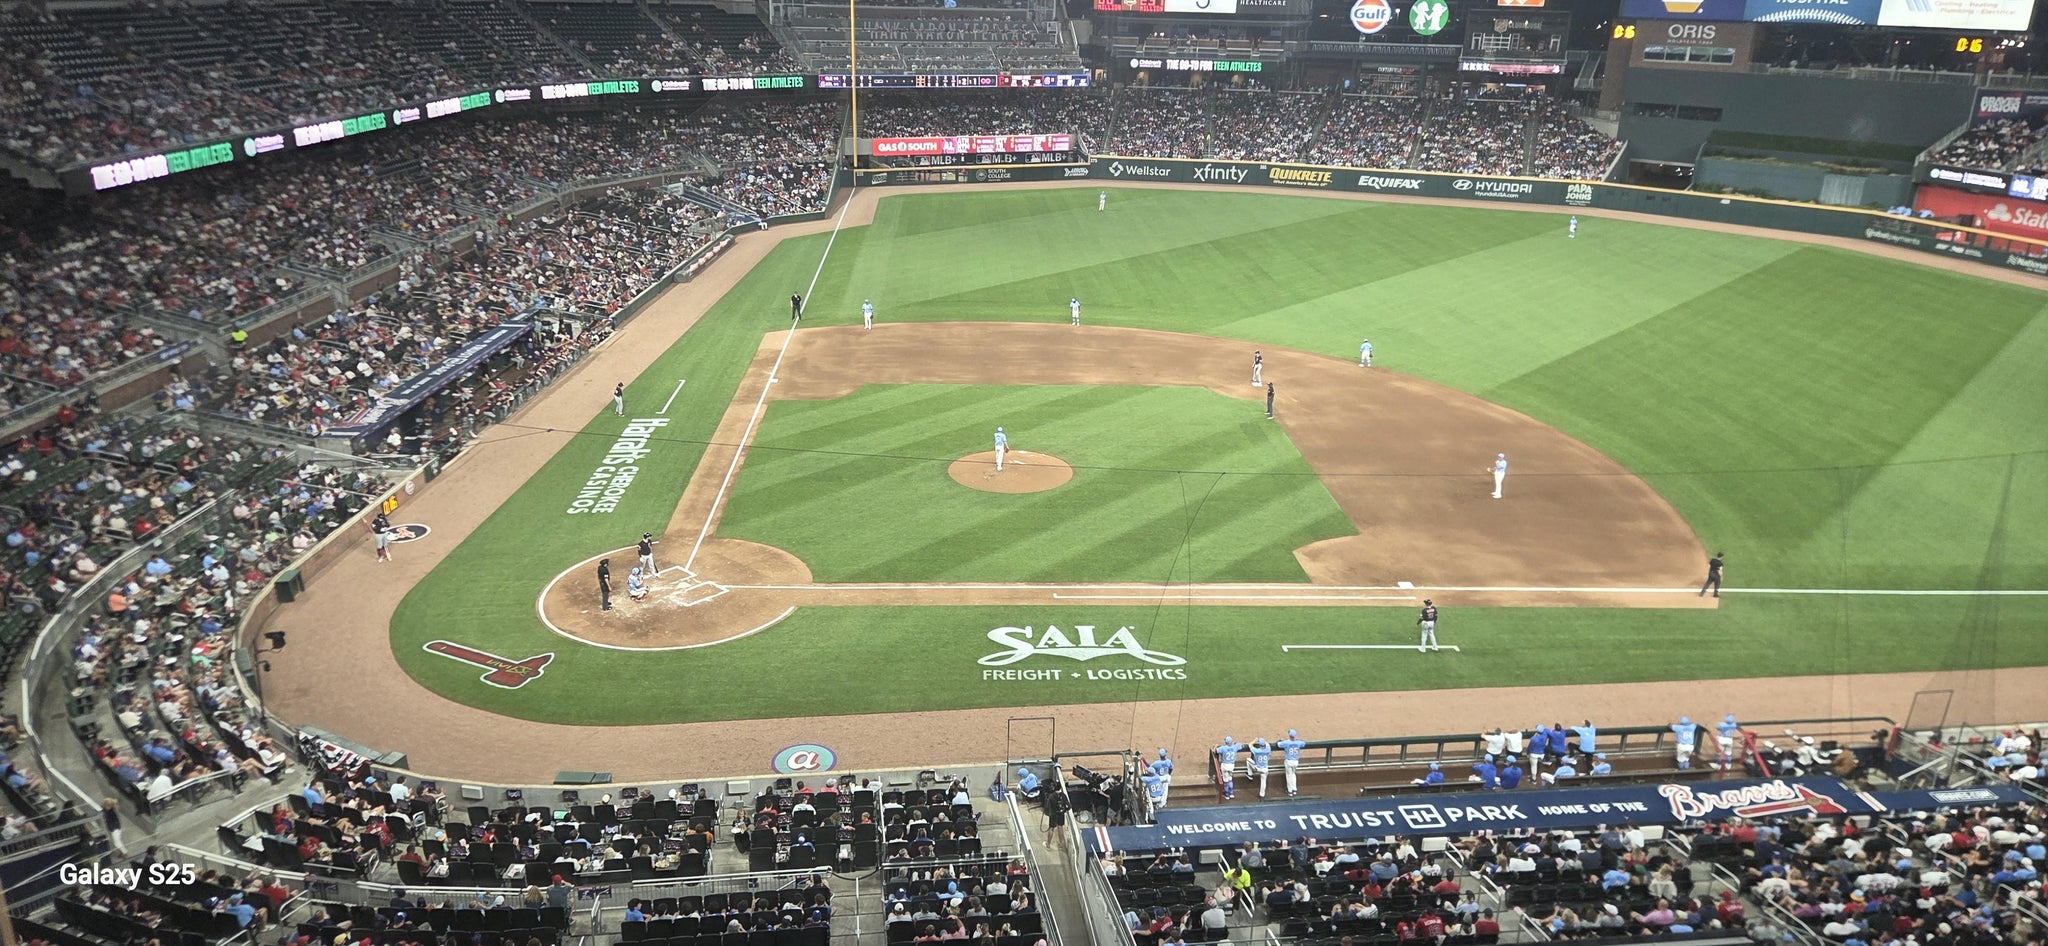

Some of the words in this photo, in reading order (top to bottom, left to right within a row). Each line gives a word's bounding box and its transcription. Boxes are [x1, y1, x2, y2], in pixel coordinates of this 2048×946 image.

[1354, 9, 1387, 20] Gulf
[1668, 24, 1716, 39] ORIS
[1214, 61, 1229, 71] TEEN
[1230, 61, 1261, 72] ATHLETES
[588, 82, 603, 95] TEEN
[603, 81, 639, 94] ATHLETES
[754, 78, 770, 88] TEEN
[772, 77, 803, 88] ATHLETES
[1980, 102, 2020, 113] VISION
[878, 143, 897, 152] GAS
[907, 142, 937, 151] SOUTH
[931, 156, 957, 165] MLB+
[1042, 153, 1066, 162] MLB+
[1126, 164, 1171, 177] Wellstar
[1193, 163, 1249, 183] xfinity
[1269, 167, 1332, 182] QUIKRETE
[1358, 175, 1421, 190] EQUIFAX
[1476, 181, 1533, 194] HYUNDAI
[1568, 184, 1592, 194] PAPA
[1565, 193, 1592, 201] JOHNS
[566, 466, 616, 514] CASINOS
[591, 466, 640, 513] CHEROKEE
[977, 625, 1188, 666] SAIA
[983, 669, 1062, 681] FREIGHT
[1087, 669, 1188, 680] LOGISTICS
[1225, 751, 1236, 761] 22
[1150, 784, 1161, 793] 82
[1167, 821, 1252, 835] WELCOME
[1254, 819, 1277, 830] TO
[1290, 810, 1396, 831] TRUIST
[1444, 804, 1528, 823] PARK
[1538, 804, 1588, 816] HOME
[1591, 802, 1612, 813] OF
[1613, 801, 1648, 812] THE
[1657, 780, 1796, 821] Braves
